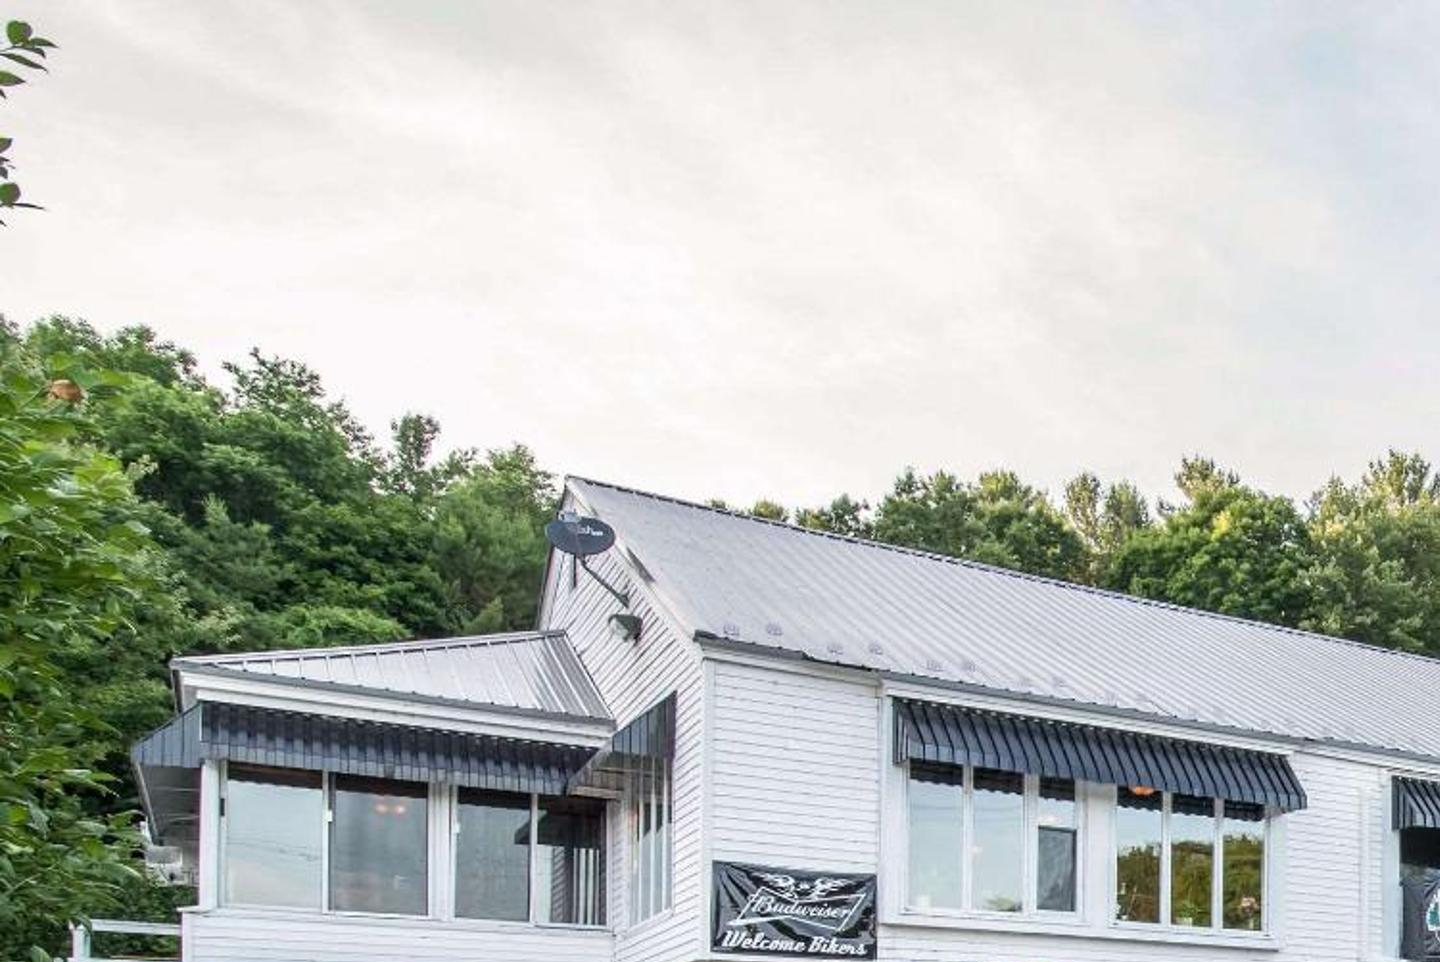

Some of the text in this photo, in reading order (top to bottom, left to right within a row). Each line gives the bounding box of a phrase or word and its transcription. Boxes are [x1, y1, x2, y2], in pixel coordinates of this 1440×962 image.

[751, 896, 853, 919] Budweiser
[721, 930, 868, 956] Welcome Bikers
